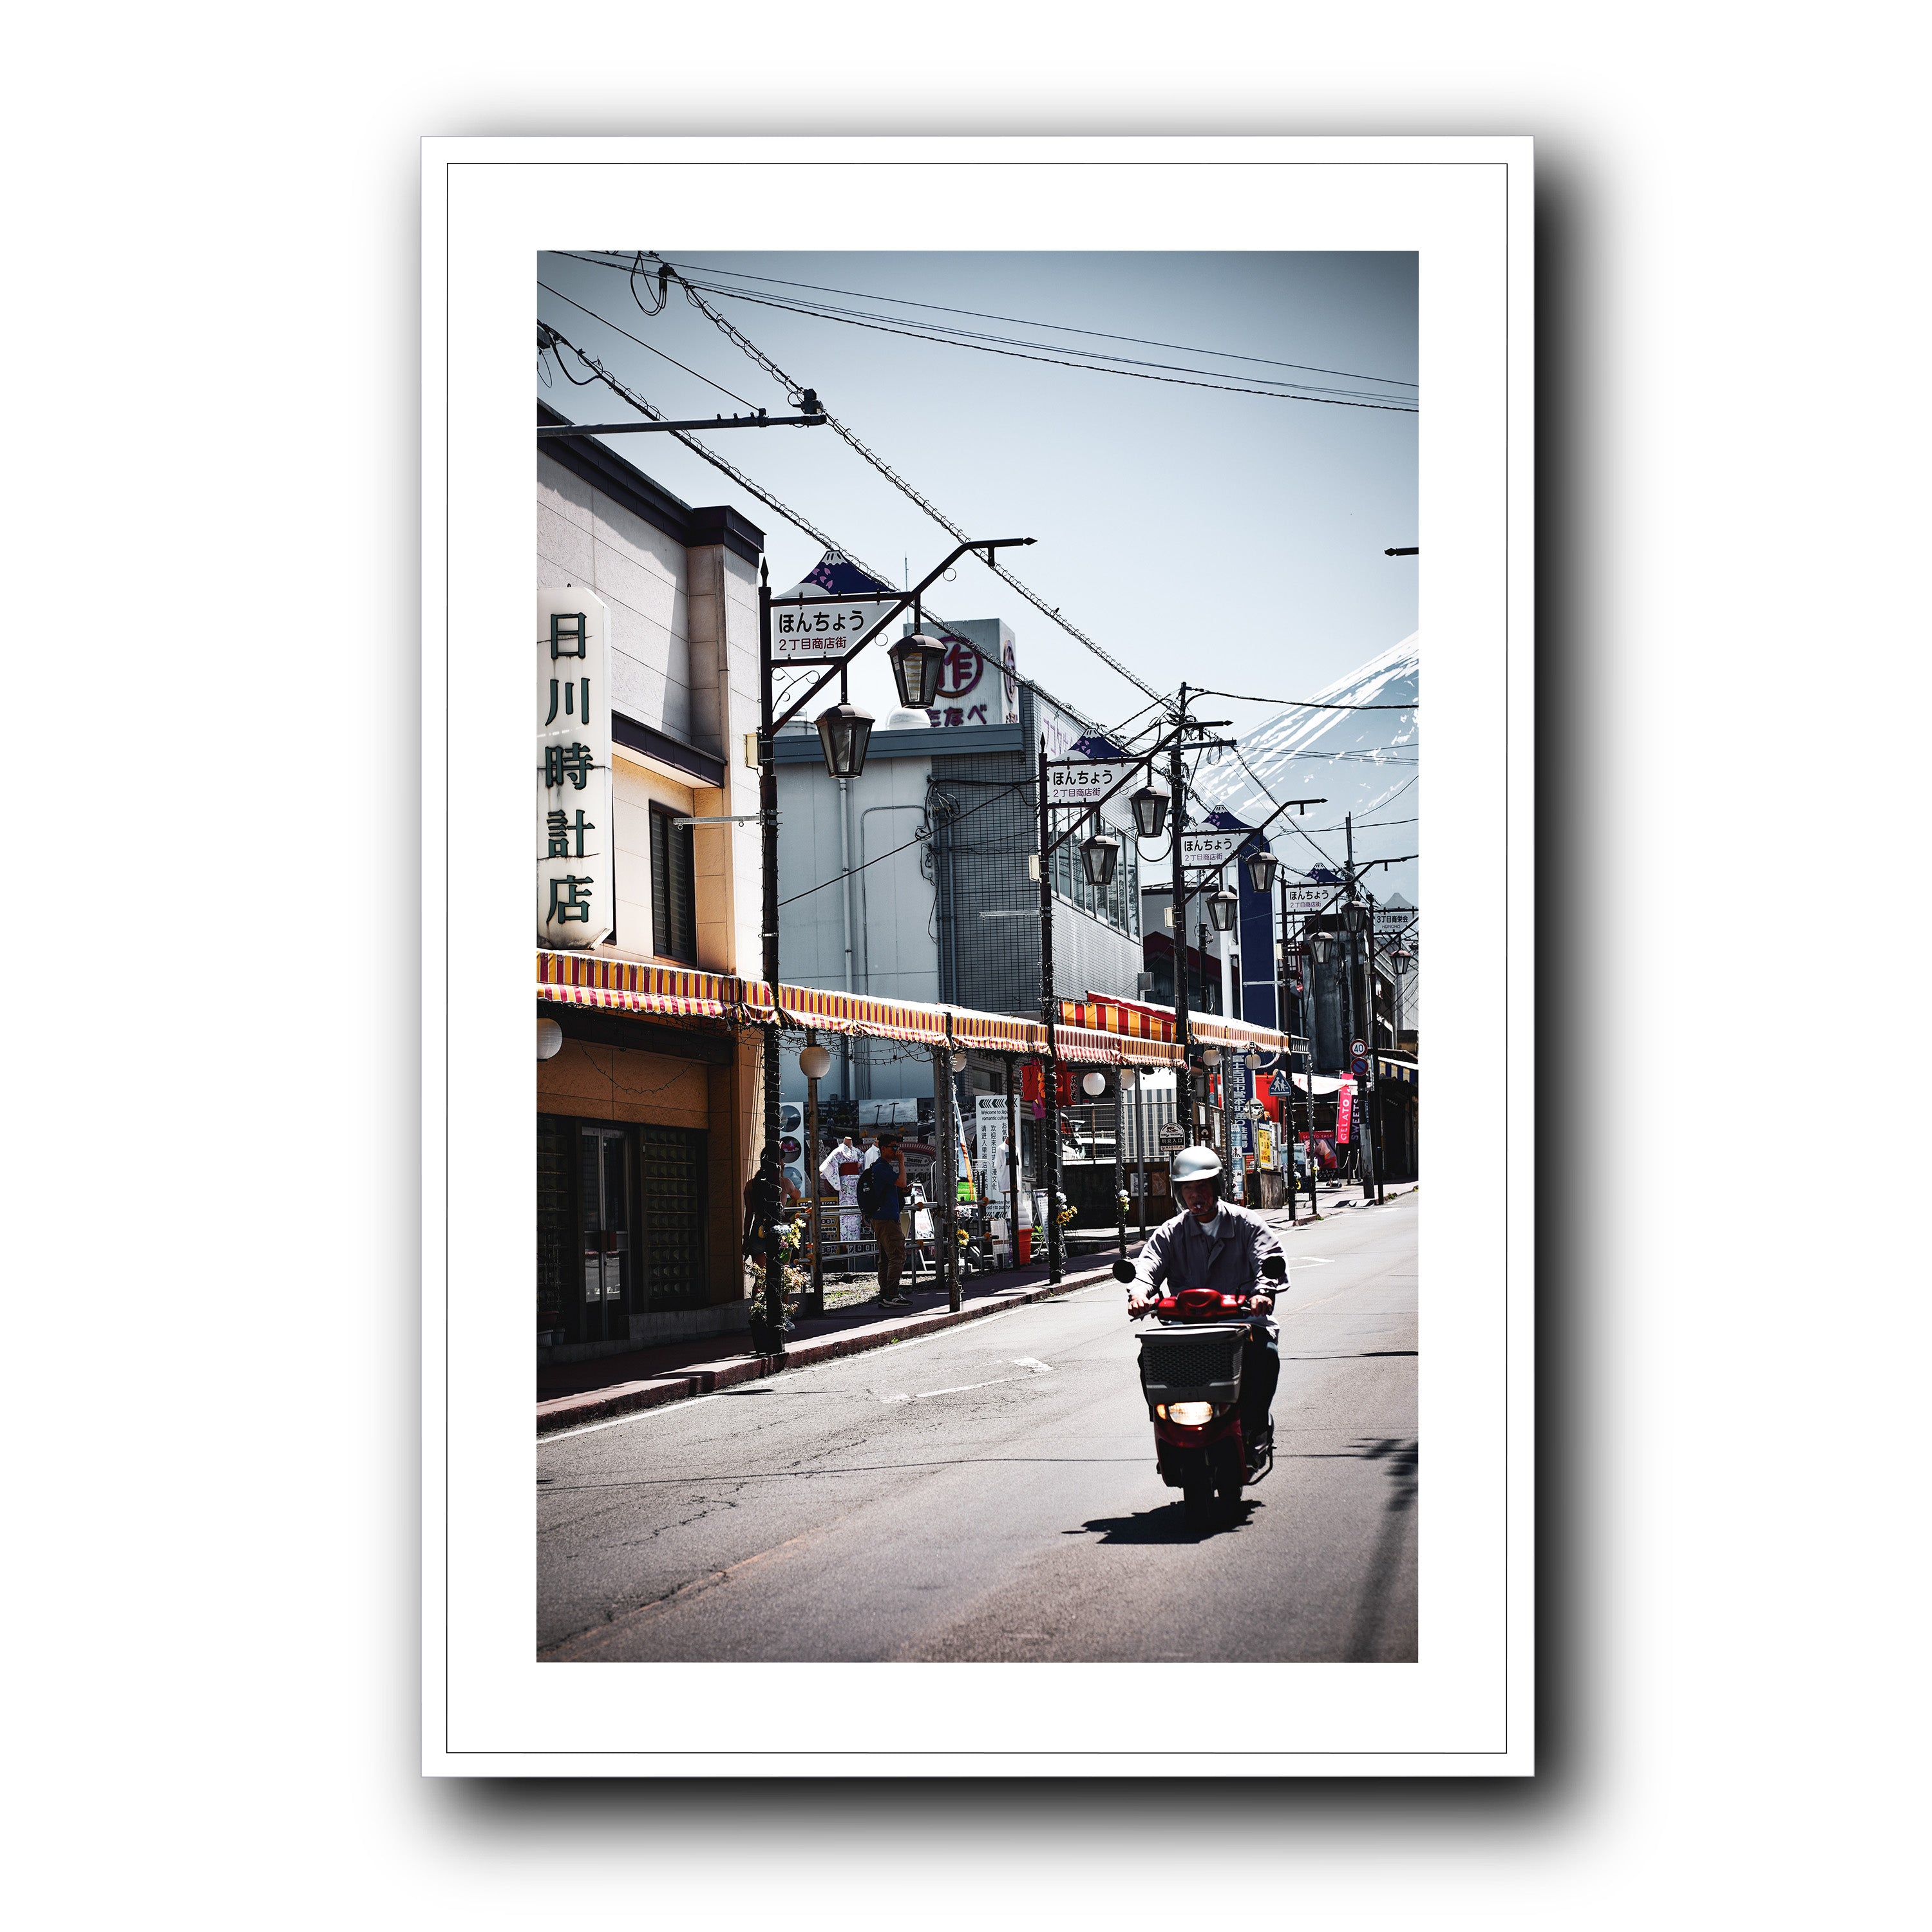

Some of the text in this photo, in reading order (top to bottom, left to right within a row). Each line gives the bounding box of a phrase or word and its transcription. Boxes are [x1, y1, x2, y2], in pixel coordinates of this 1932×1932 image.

[779, 610, 864, 633] ほんちょう
[779, 637, 847, 650] 2丁目商店街
[545, 612, 595, 924] 日川時計店
[1053, 770, 1113, 785] ほんちょう
[1053, 788, 1101, 797] 2丁目商店街
[1184, 838, 1232, 851] ほんちょう
[1290, 889, 1329, 900] ほんちょう
[1354, 1044, 1364, 1052] 40
[1341, 1099, 1350, 1141] GELATO
[1351, 1098, 1360, 1141] SWEETS
